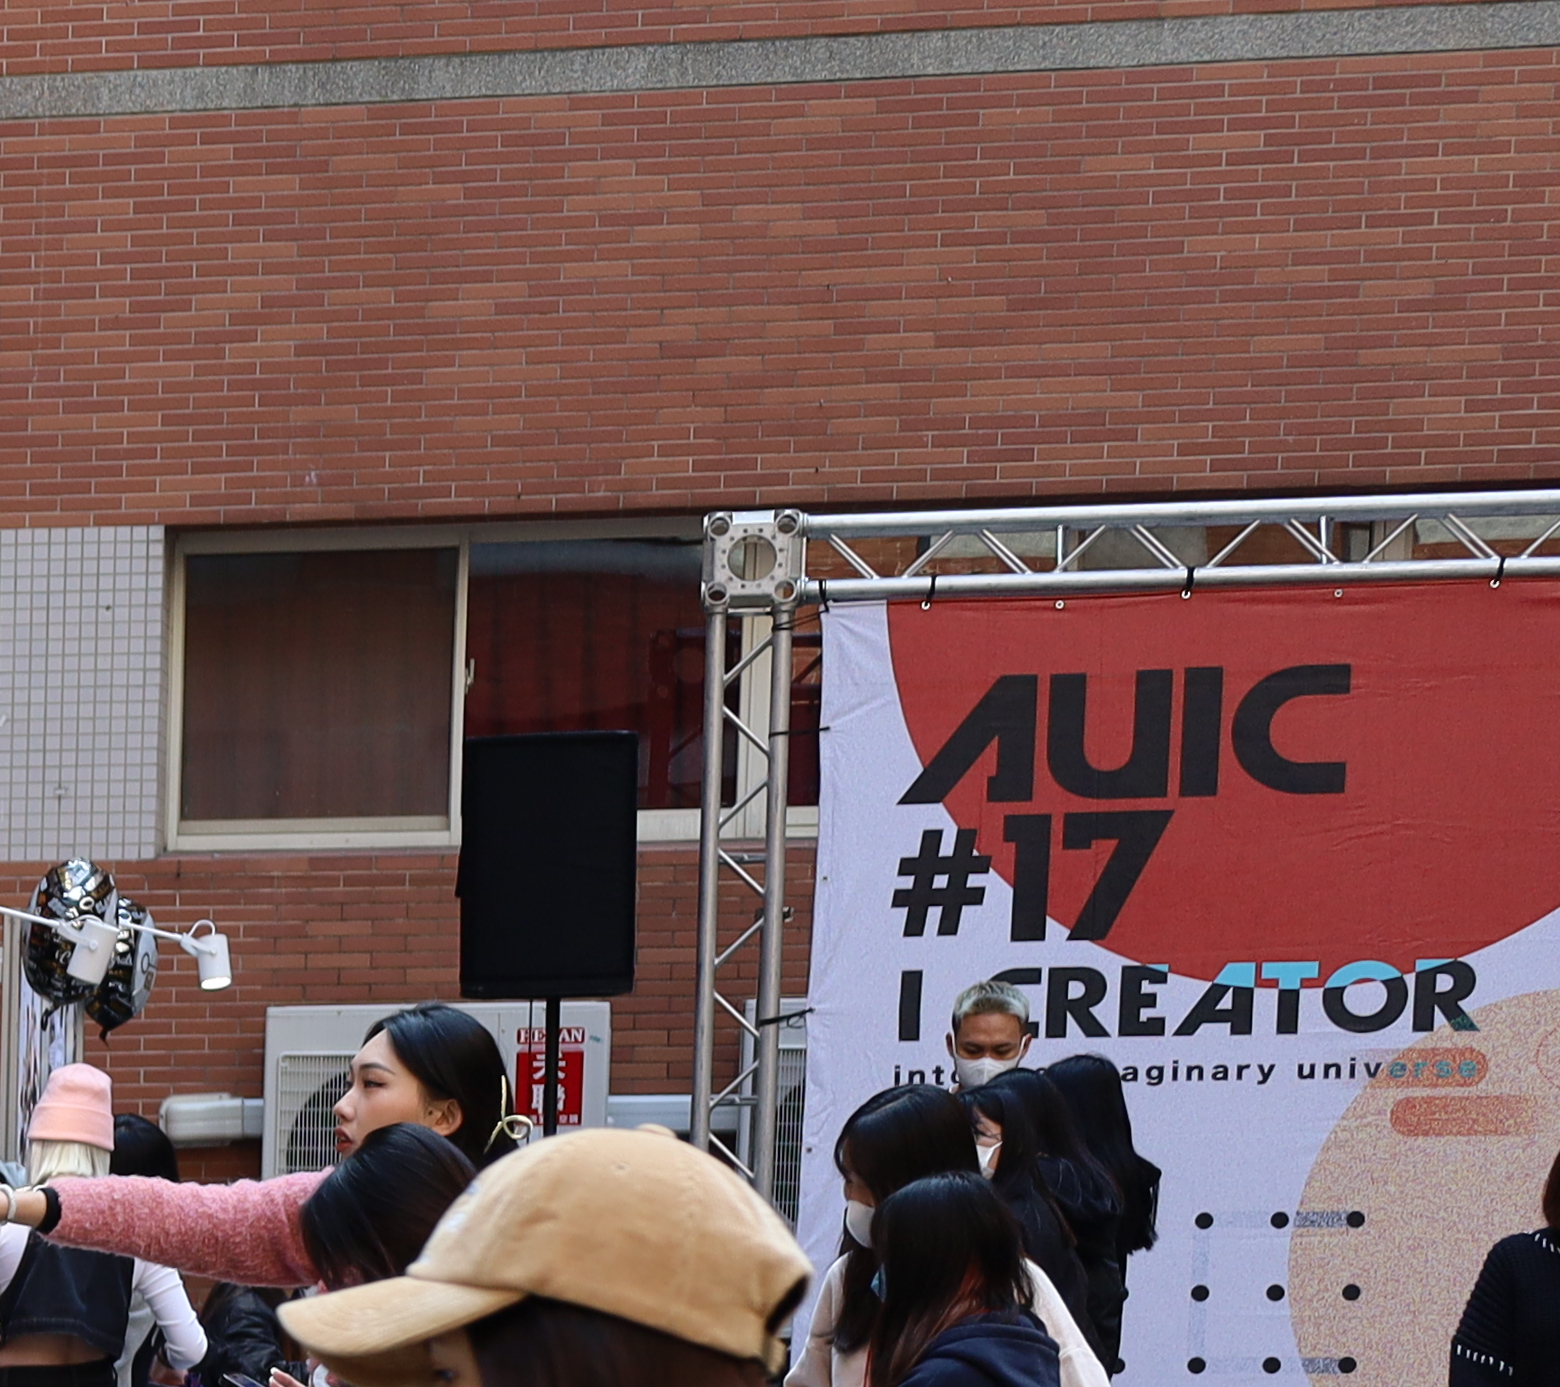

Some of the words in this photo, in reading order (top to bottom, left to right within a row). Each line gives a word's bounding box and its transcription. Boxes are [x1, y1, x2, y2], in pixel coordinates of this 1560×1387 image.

[897, 664, 1352, 805] AUIC
[891, 810, 1175, 942] #17
[519, 1028, 583, 1044] HEAN
[1120, 1059, 1276, 1085] aginary
[1296, 1057, 1479, 1081] universe
